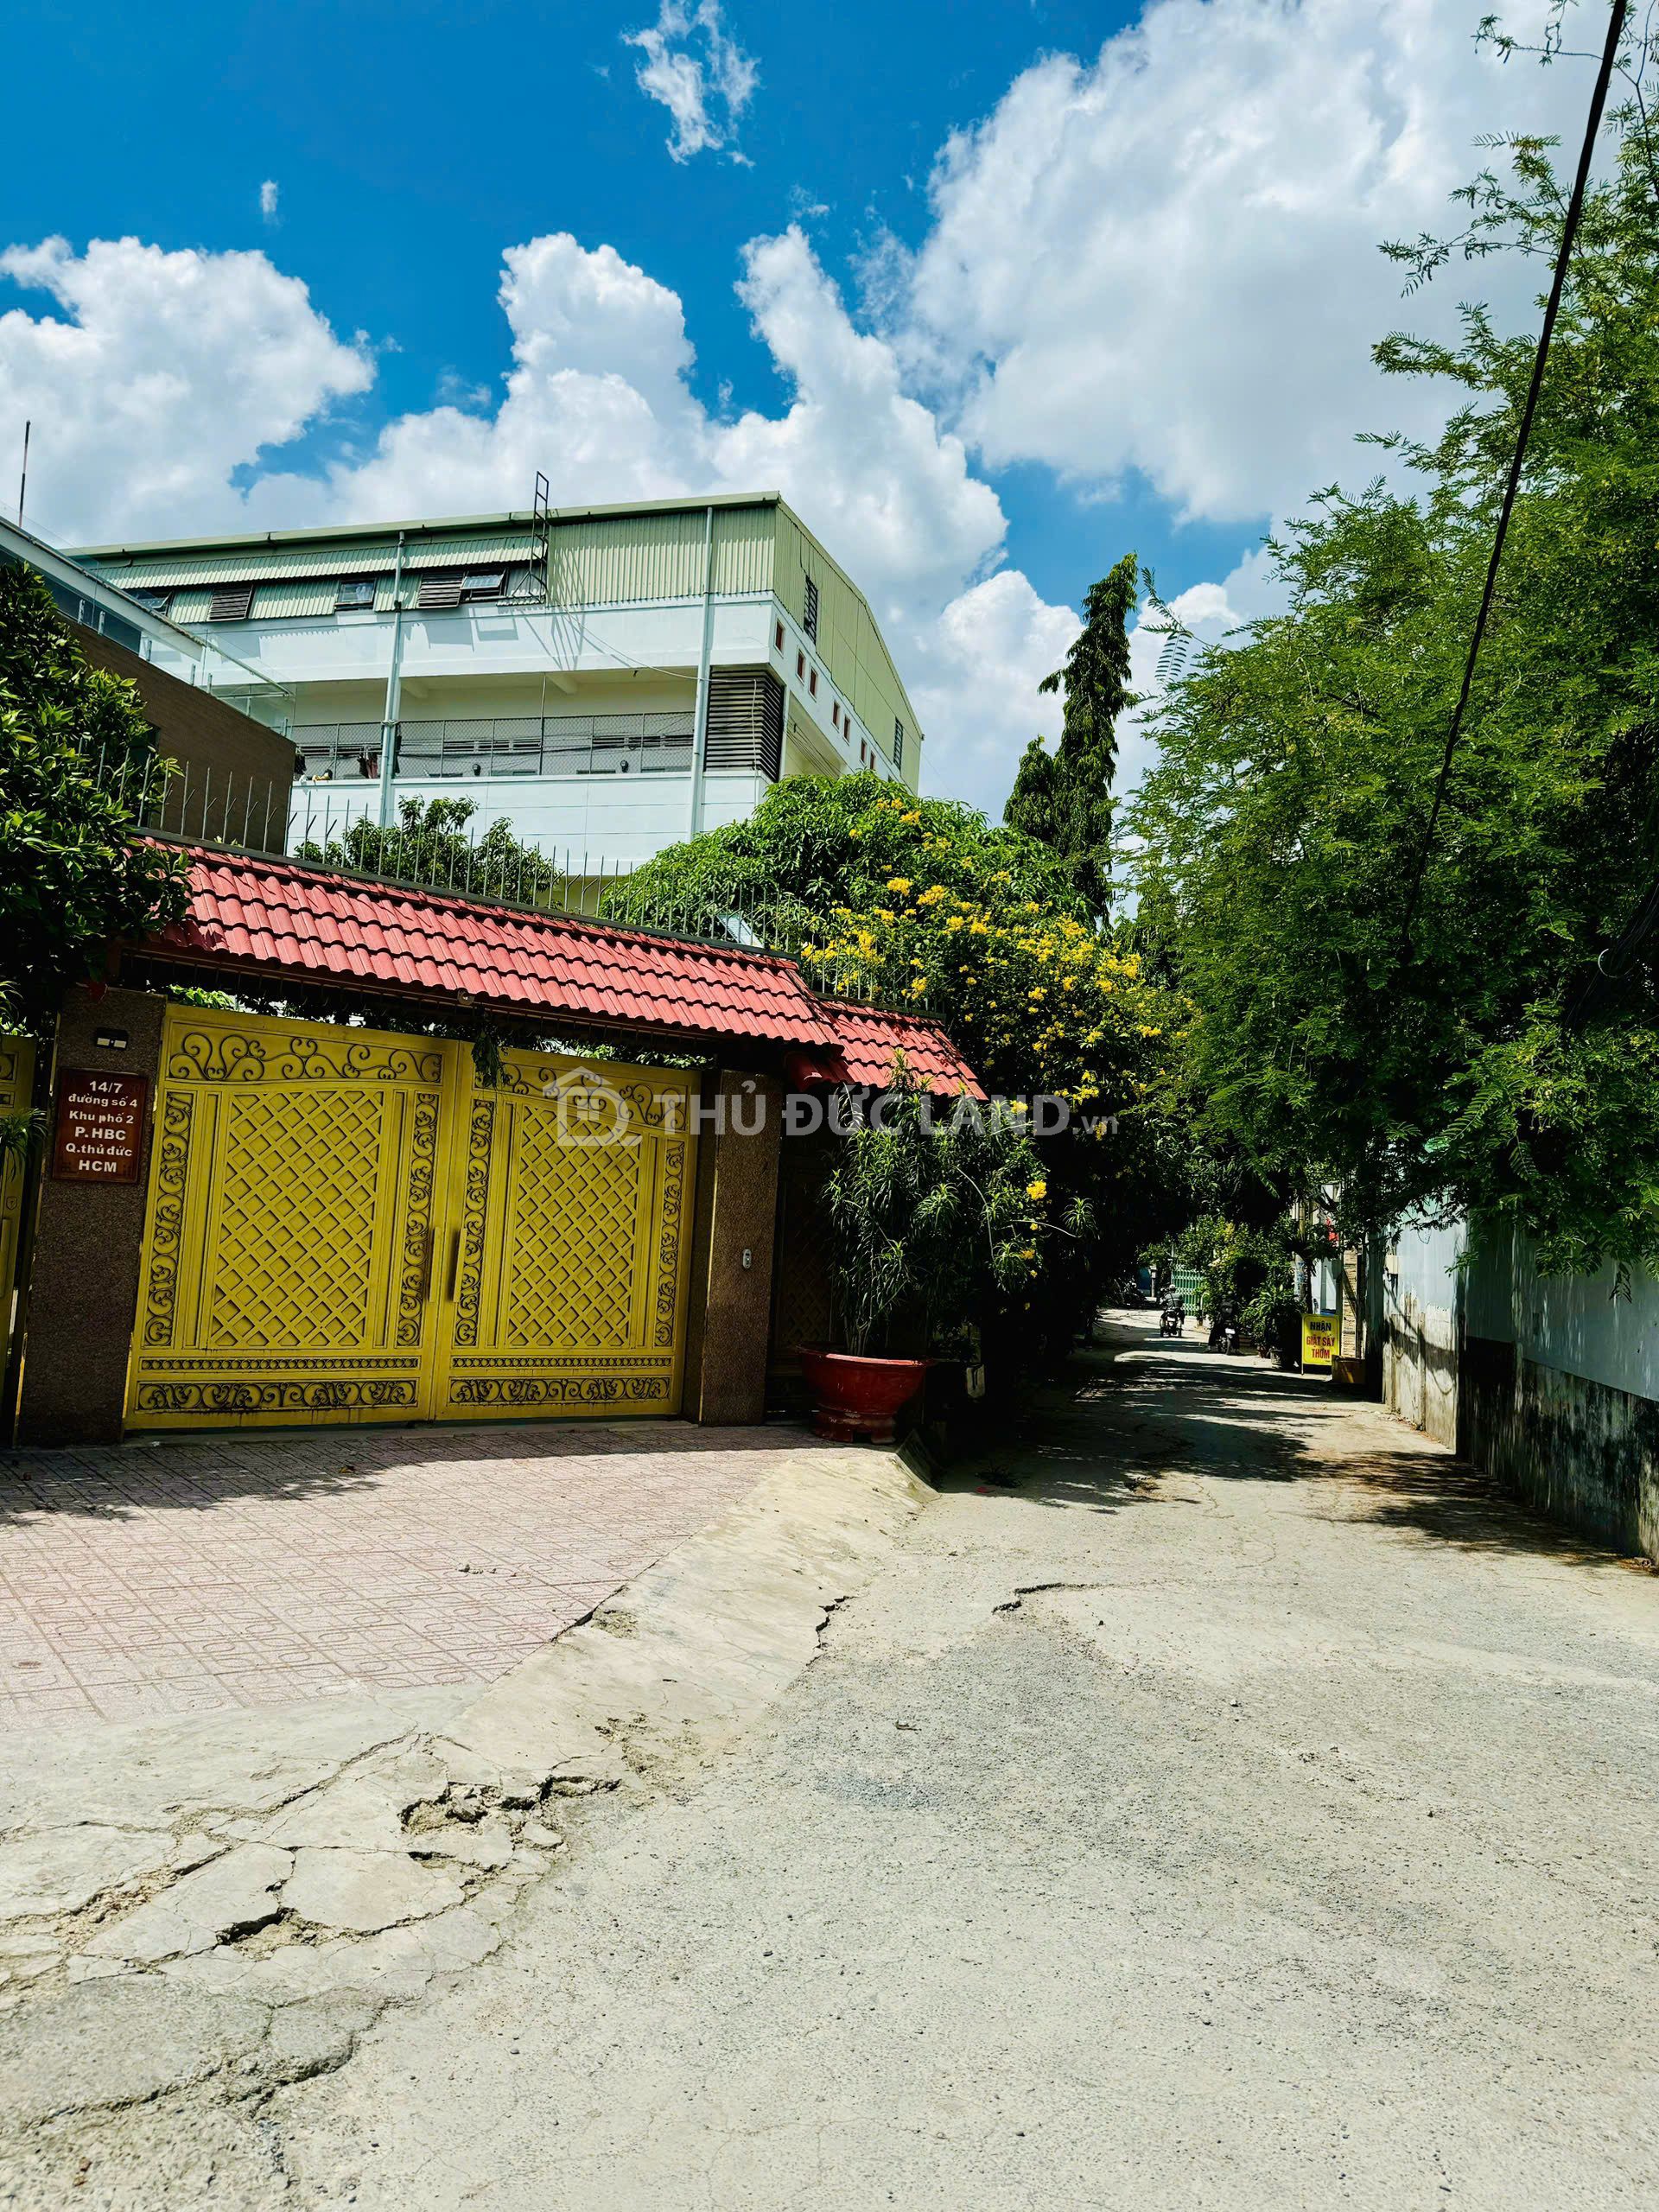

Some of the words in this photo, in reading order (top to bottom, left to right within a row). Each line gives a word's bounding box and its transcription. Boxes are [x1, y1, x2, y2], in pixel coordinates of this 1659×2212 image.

[89, 1081, 124, 1094] 14/7
[68, 1093, 108, 1107] đường
[111, 1096, 129, 1106] số
[130, 1099, 137, 1108] 4
[69, 1110, 95, 1120] Khu
[99, 1112, 124, 1123] phố
[126, 1116, 134, 1124] 2
[106, 1146, 132, 1156] đức
[79, 1160, 117, 1173] HCM
[1310, 1320, 1332, 1332] NHẬN
